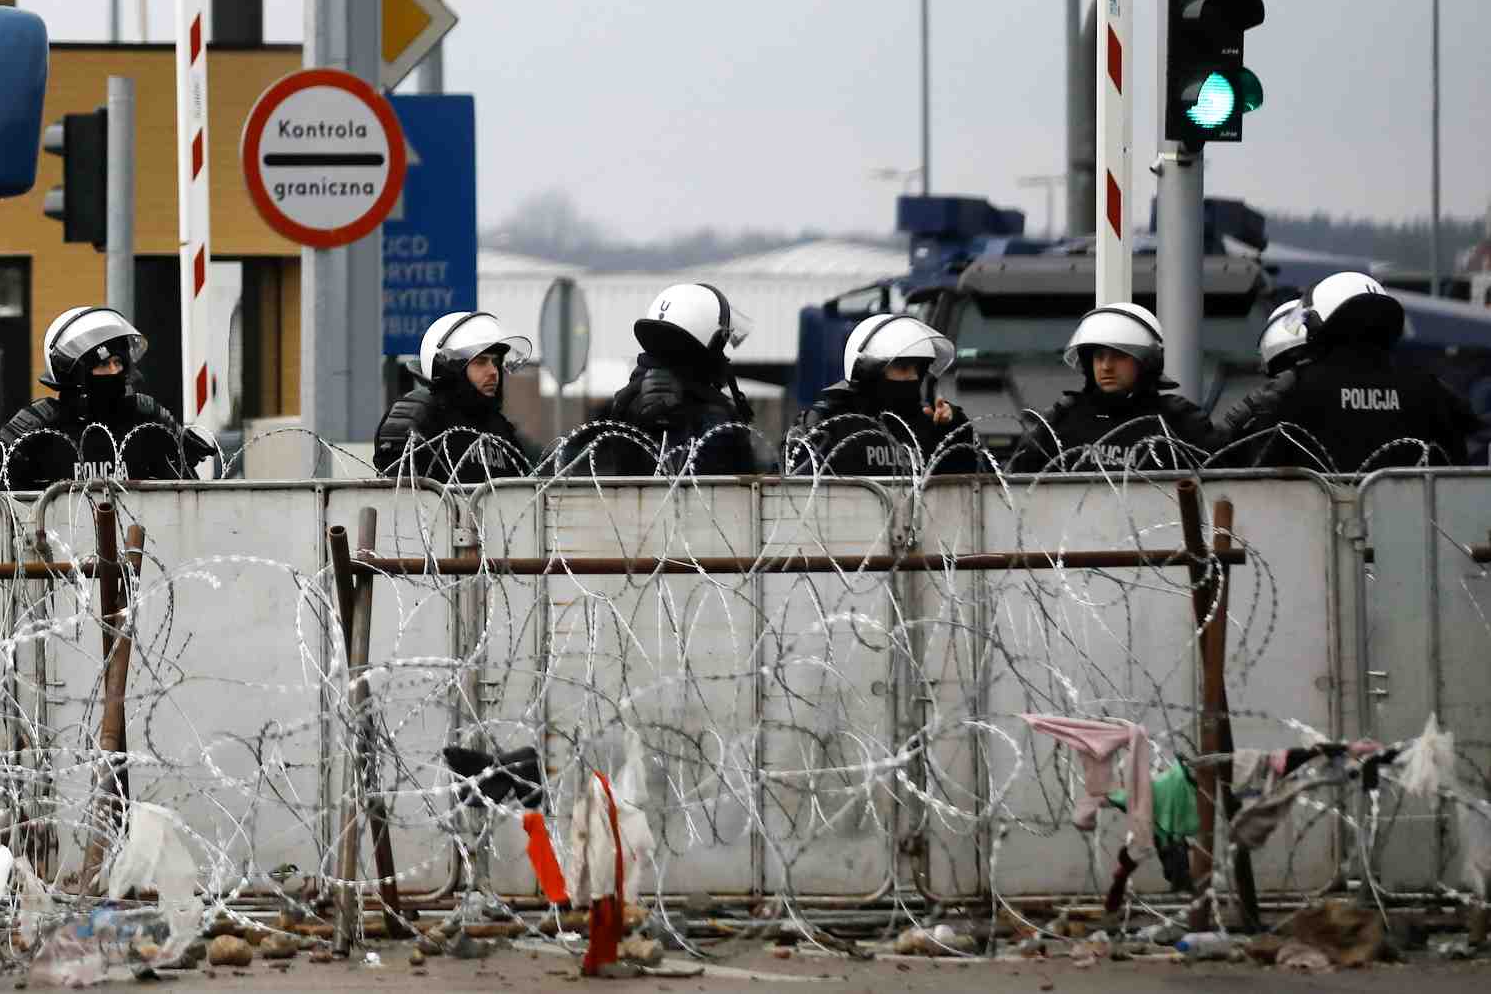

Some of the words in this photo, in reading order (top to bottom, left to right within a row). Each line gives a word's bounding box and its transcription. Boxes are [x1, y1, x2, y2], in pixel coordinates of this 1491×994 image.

[277, 120, 368, 140] Kontrola
[273, 176, 375, 201] graniczna
[1340, 388, 1400, 410] POLICJA
[866, 446, 920, 467] POLIC
